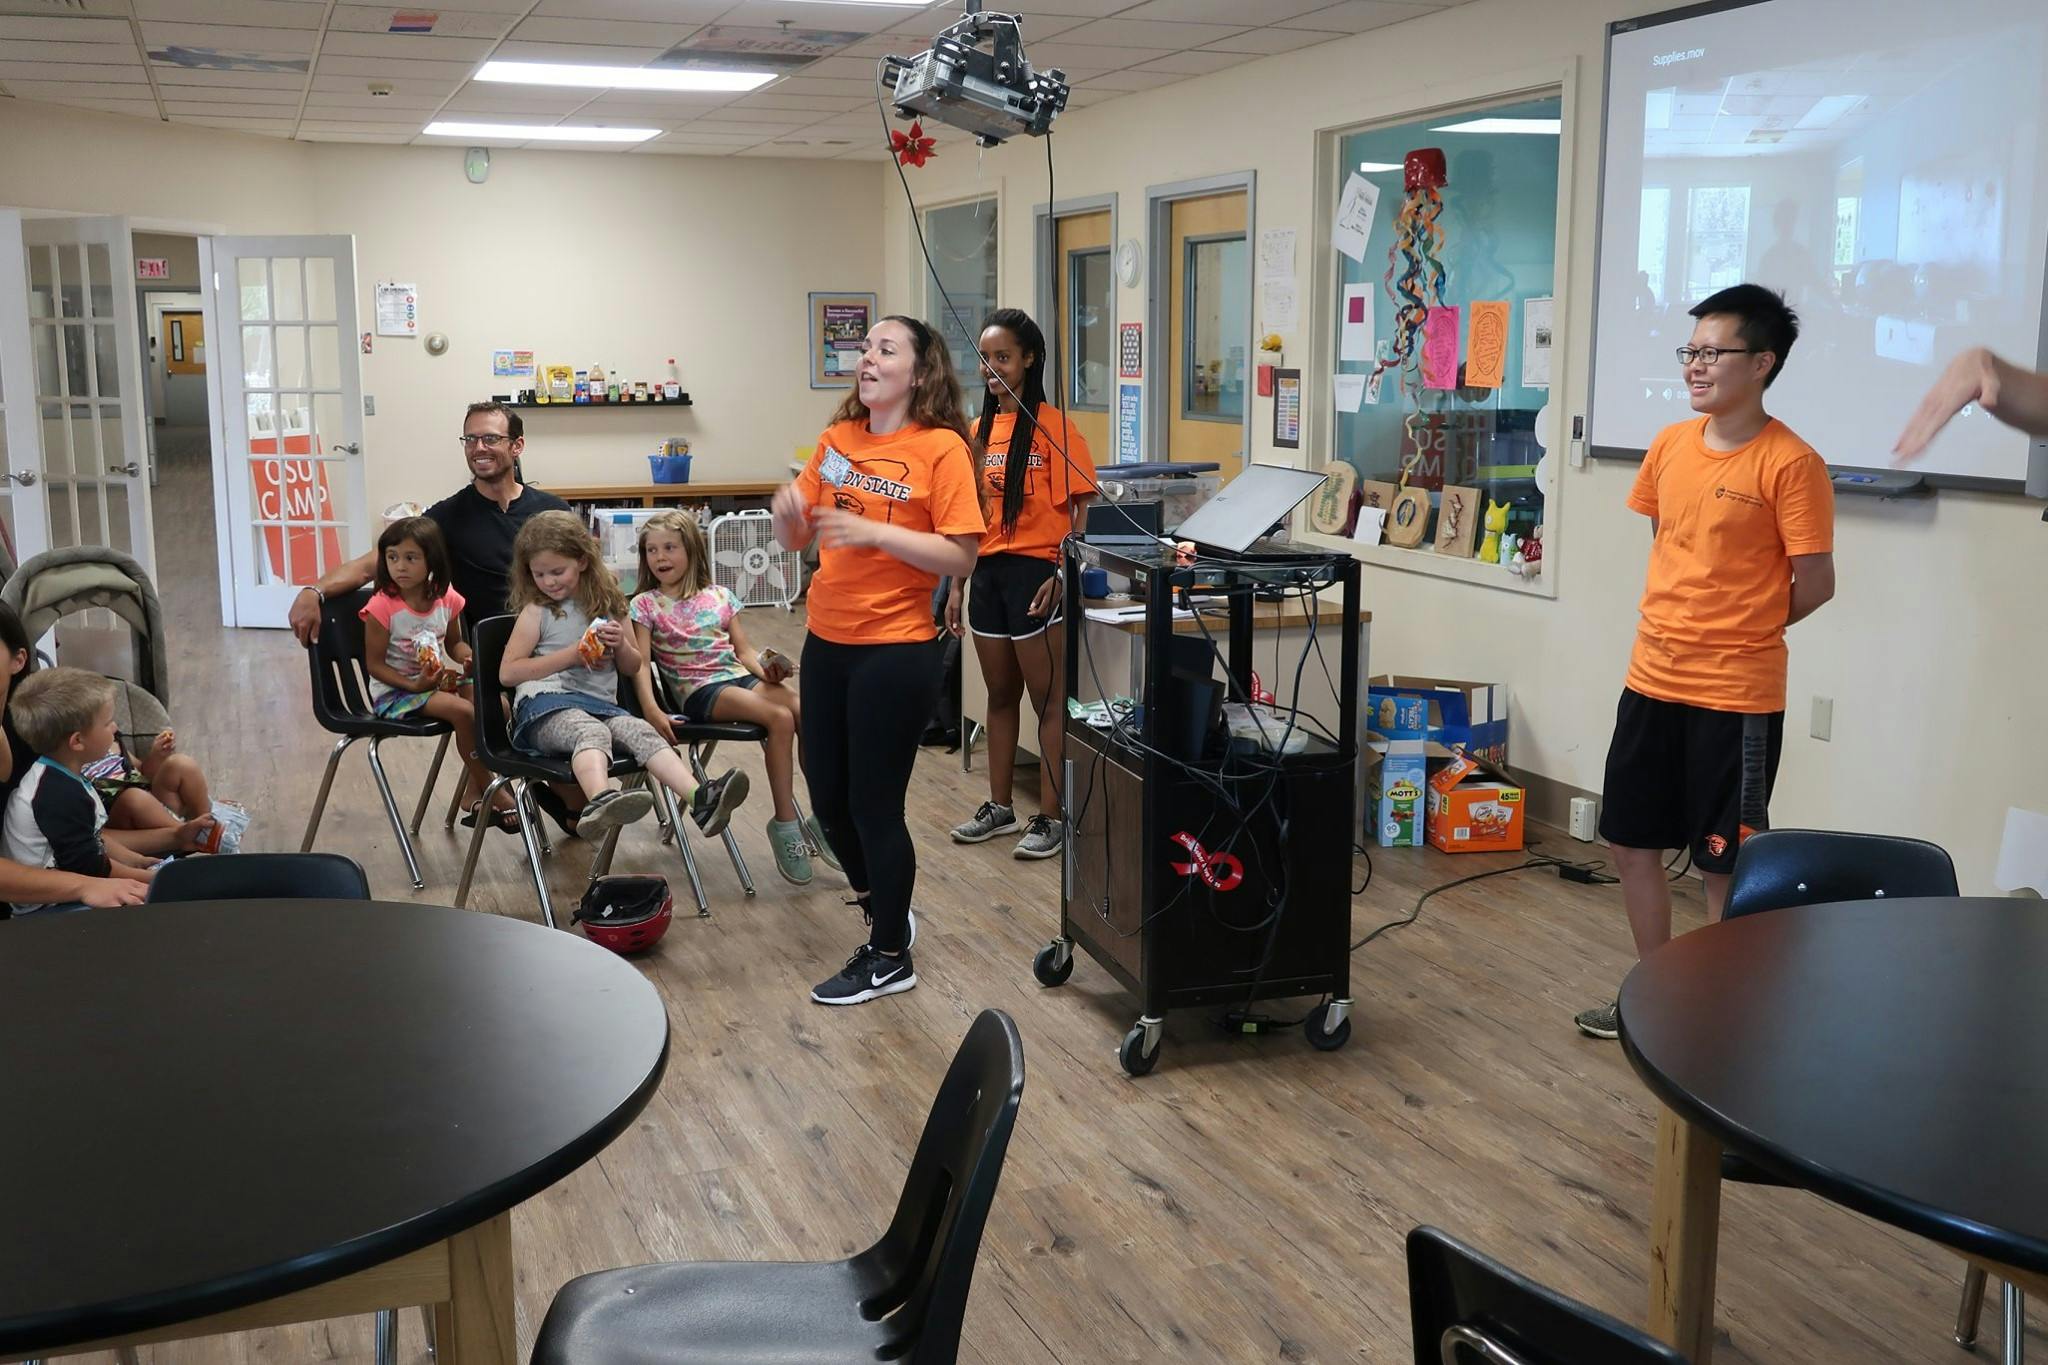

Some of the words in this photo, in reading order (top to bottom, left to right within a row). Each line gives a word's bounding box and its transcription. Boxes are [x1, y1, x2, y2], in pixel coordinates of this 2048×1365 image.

[1652, 48, 1706, 67] Supplies.mov
[264, 459, 313, 486] OSU
[863, 476, 911, 501] STATE
[1500, 792, 1510, 800] 45
